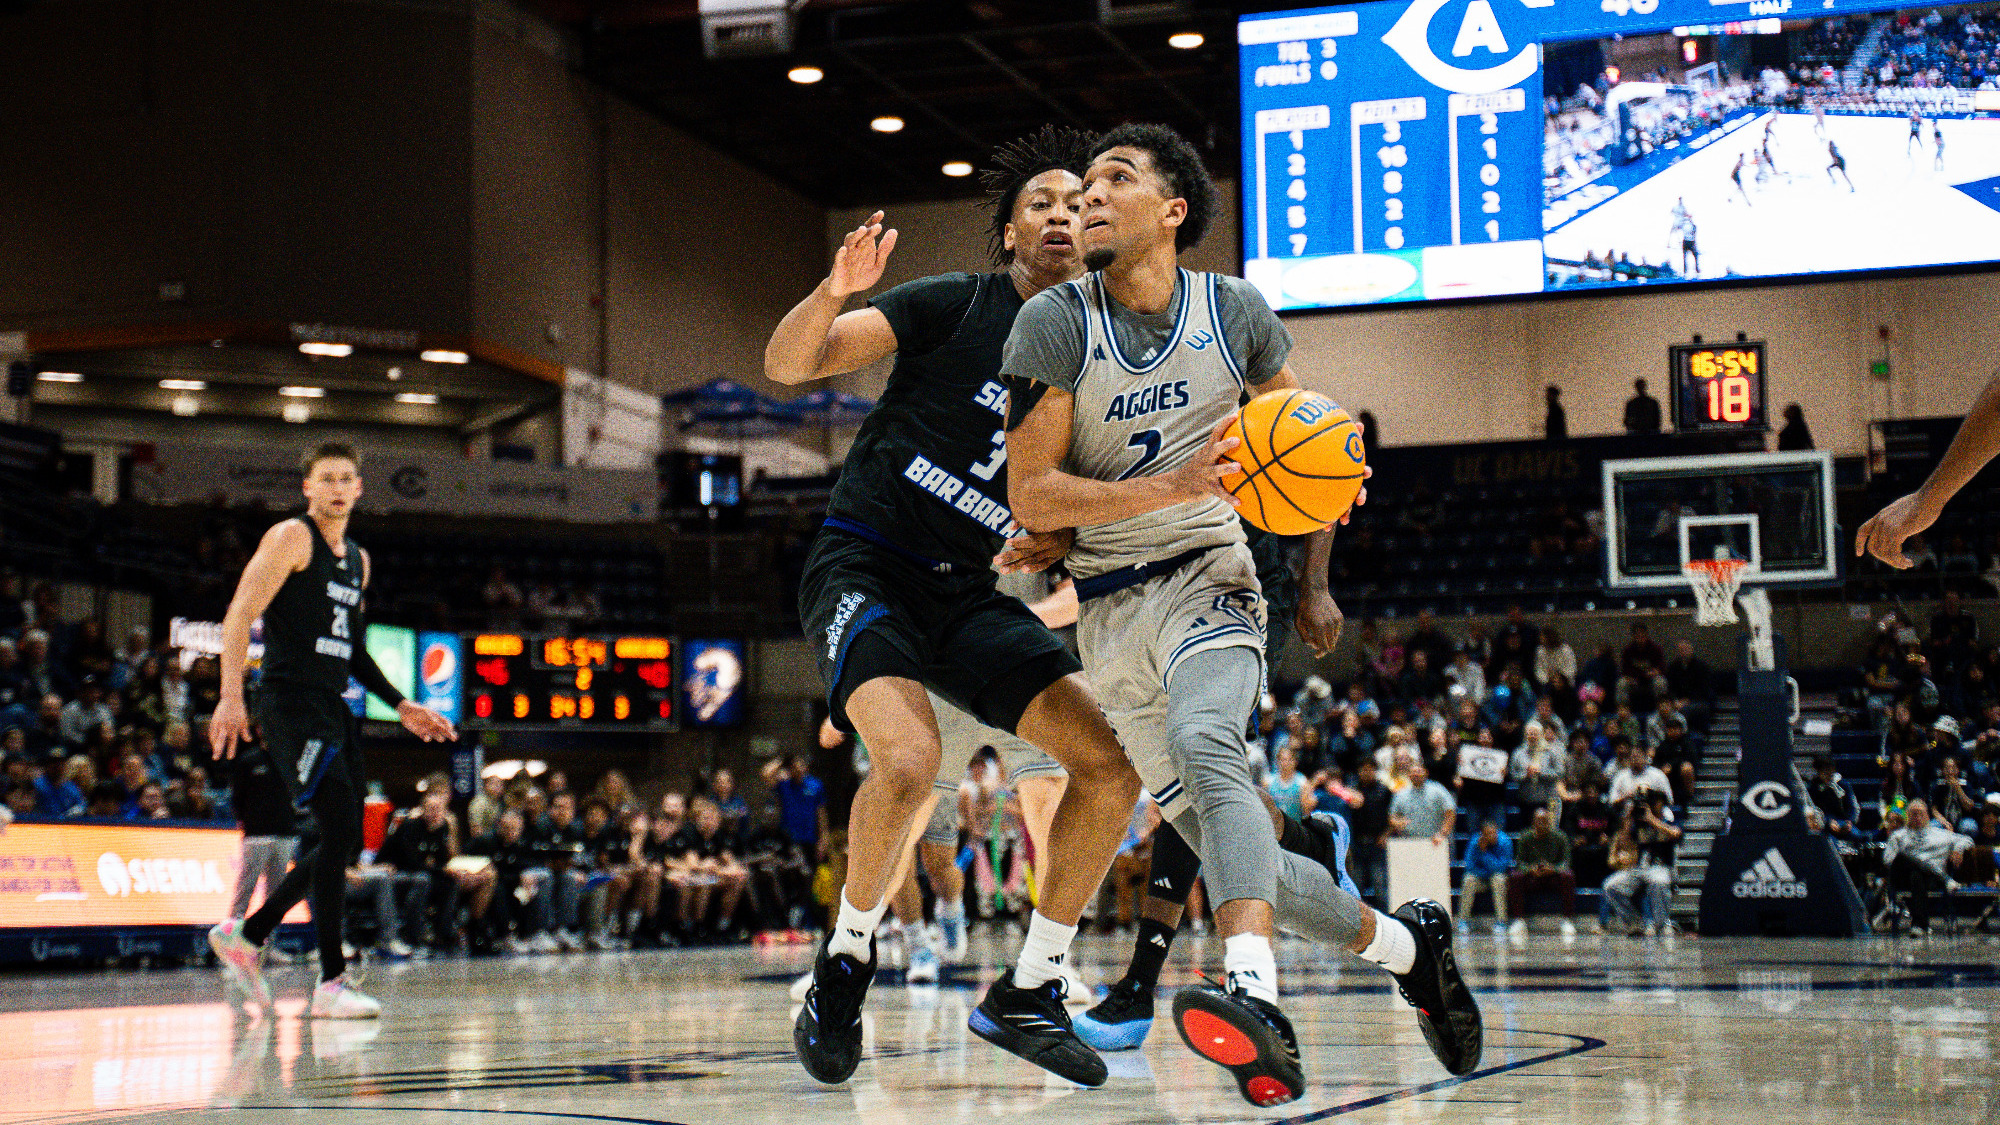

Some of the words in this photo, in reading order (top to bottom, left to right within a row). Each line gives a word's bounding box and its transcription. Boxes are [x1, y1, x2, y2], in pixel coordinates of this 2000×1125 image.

[1287, 153, 1306, 176] 2
[1480, 163, 1500, 186] 0
[1482, 191, 1501, 213] 2
[1289, 233, 1307, 256] 7
[1691, 350, 1757, 378] 16:54
[1103, 379, 1190, 423] AGGIES
[1708, 376, 1751, 422] 18
[1495, 448, 1581, 482] DAVIS
[127, 857, 225, 893] SIERRA
[1732, 881, 1809, 899] adidas
